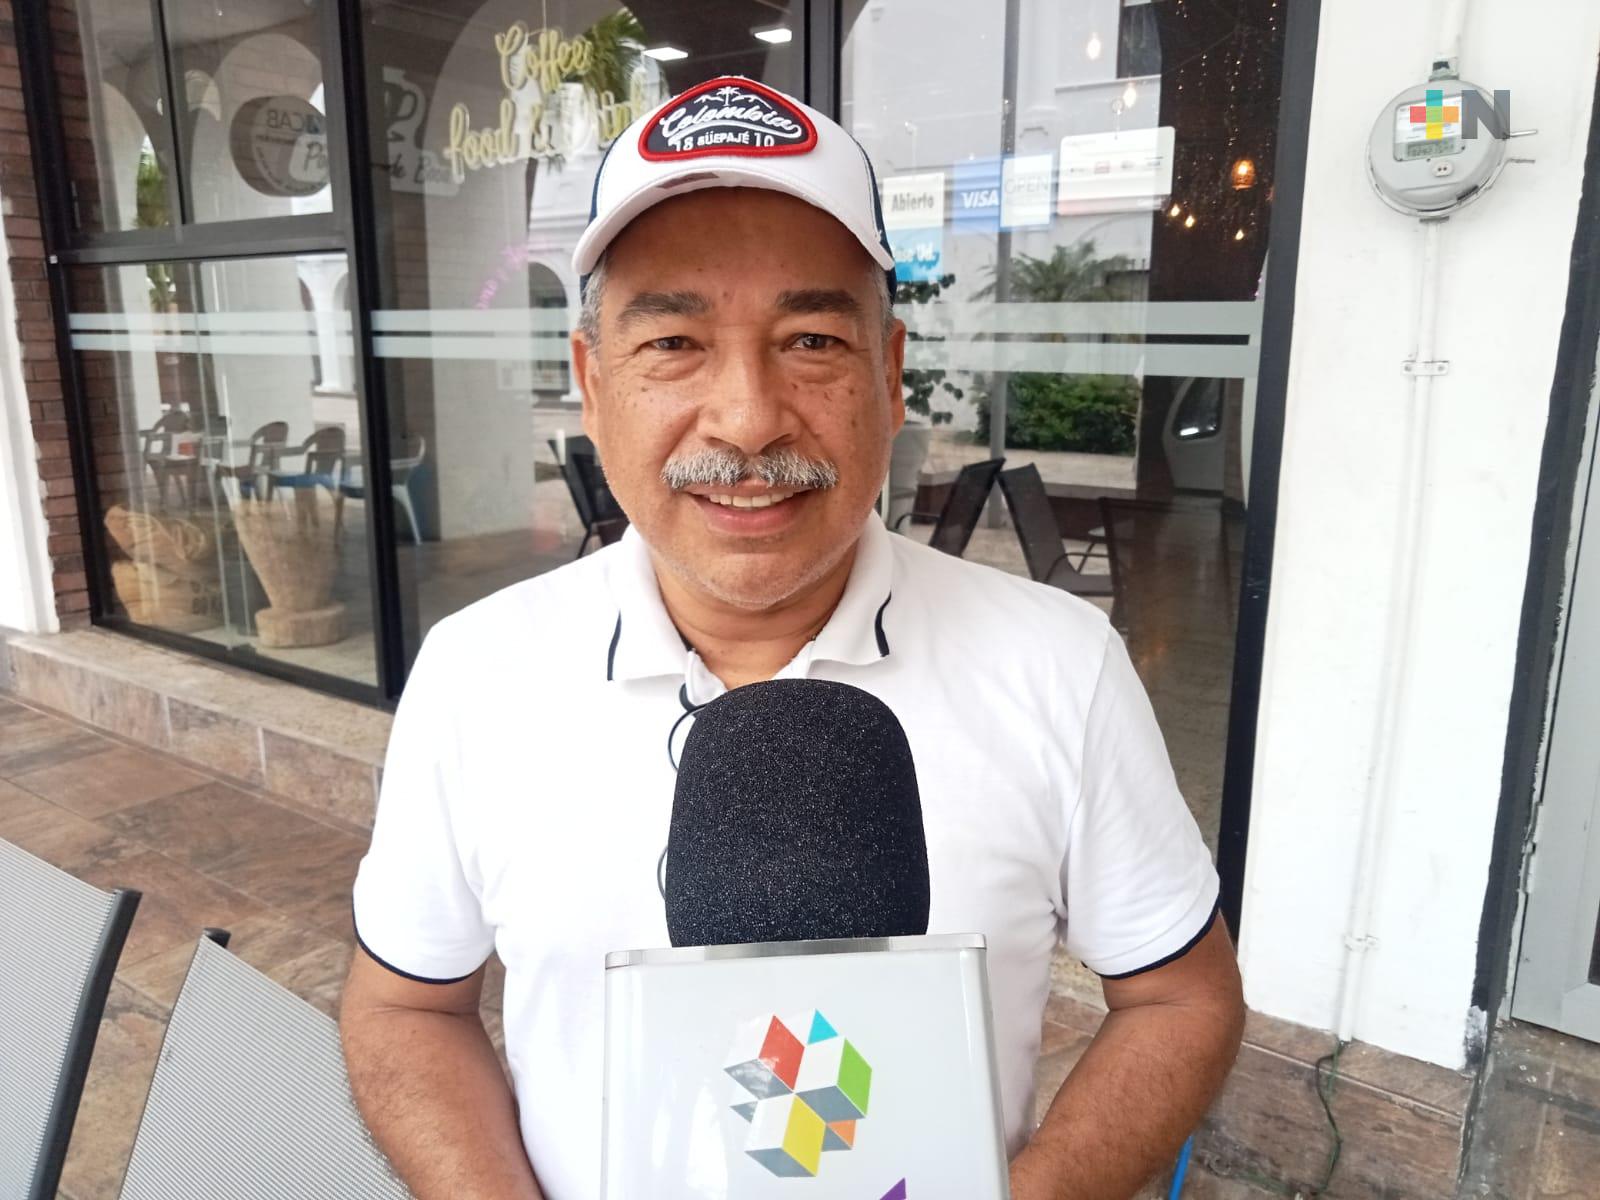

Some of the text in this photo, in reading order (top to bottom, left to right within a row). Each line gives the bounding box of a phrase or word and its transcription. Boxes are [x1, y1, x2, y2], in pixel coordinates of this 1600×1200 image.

[495, 21, 593, 93] Coffee
[659, 105, 798, 138] Colombia
[445, 99, 518, 184] food
[1004, 175, 1050, 194] OPEN
[891, 192, 935, 213] Abierto
[961, 190, 999, 208] VISA
